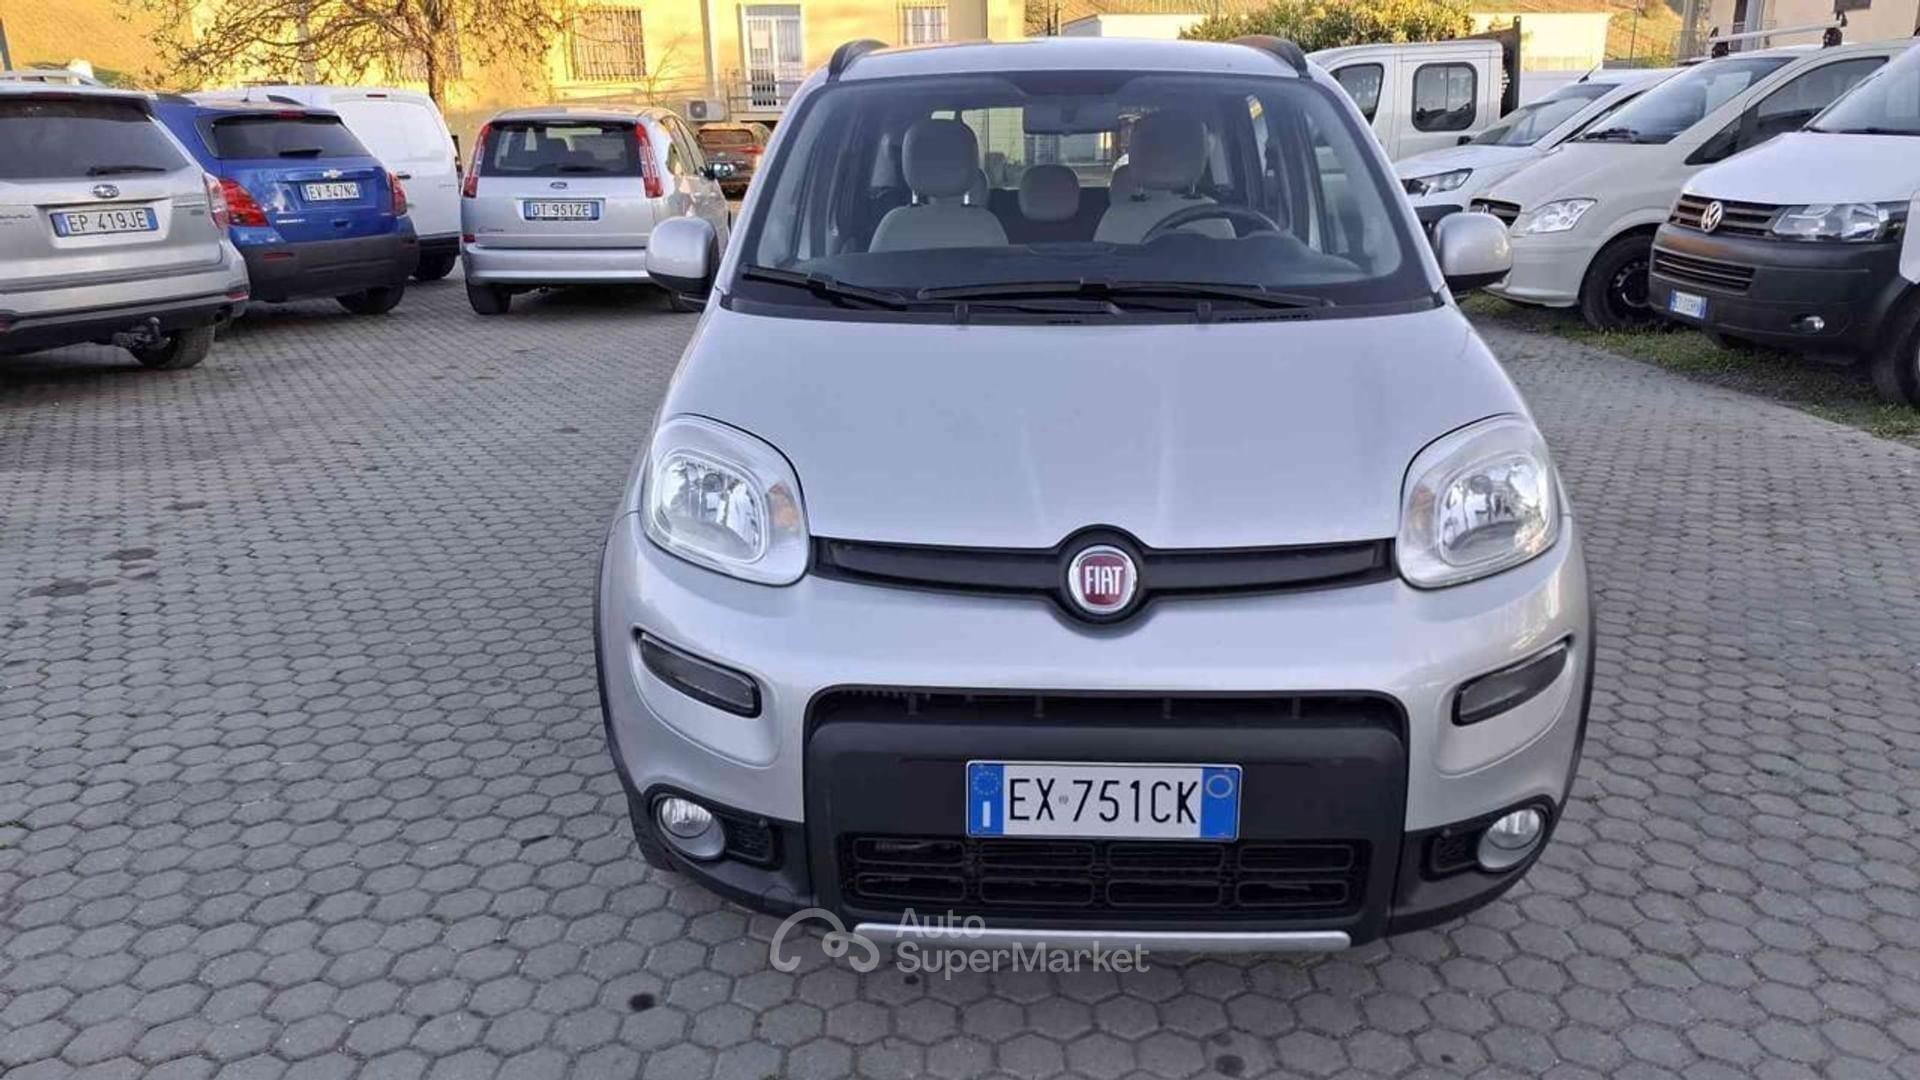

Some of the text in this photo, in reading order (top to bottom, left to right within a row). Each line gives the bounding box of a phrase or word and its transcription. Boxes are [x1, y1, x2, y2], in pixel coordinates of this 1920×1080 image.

[67, 211, 148, 232] EP 419JE
[1085, 566, 1123, 595] FIAT
[1009, 778, 1198, 824] EX 751CK
